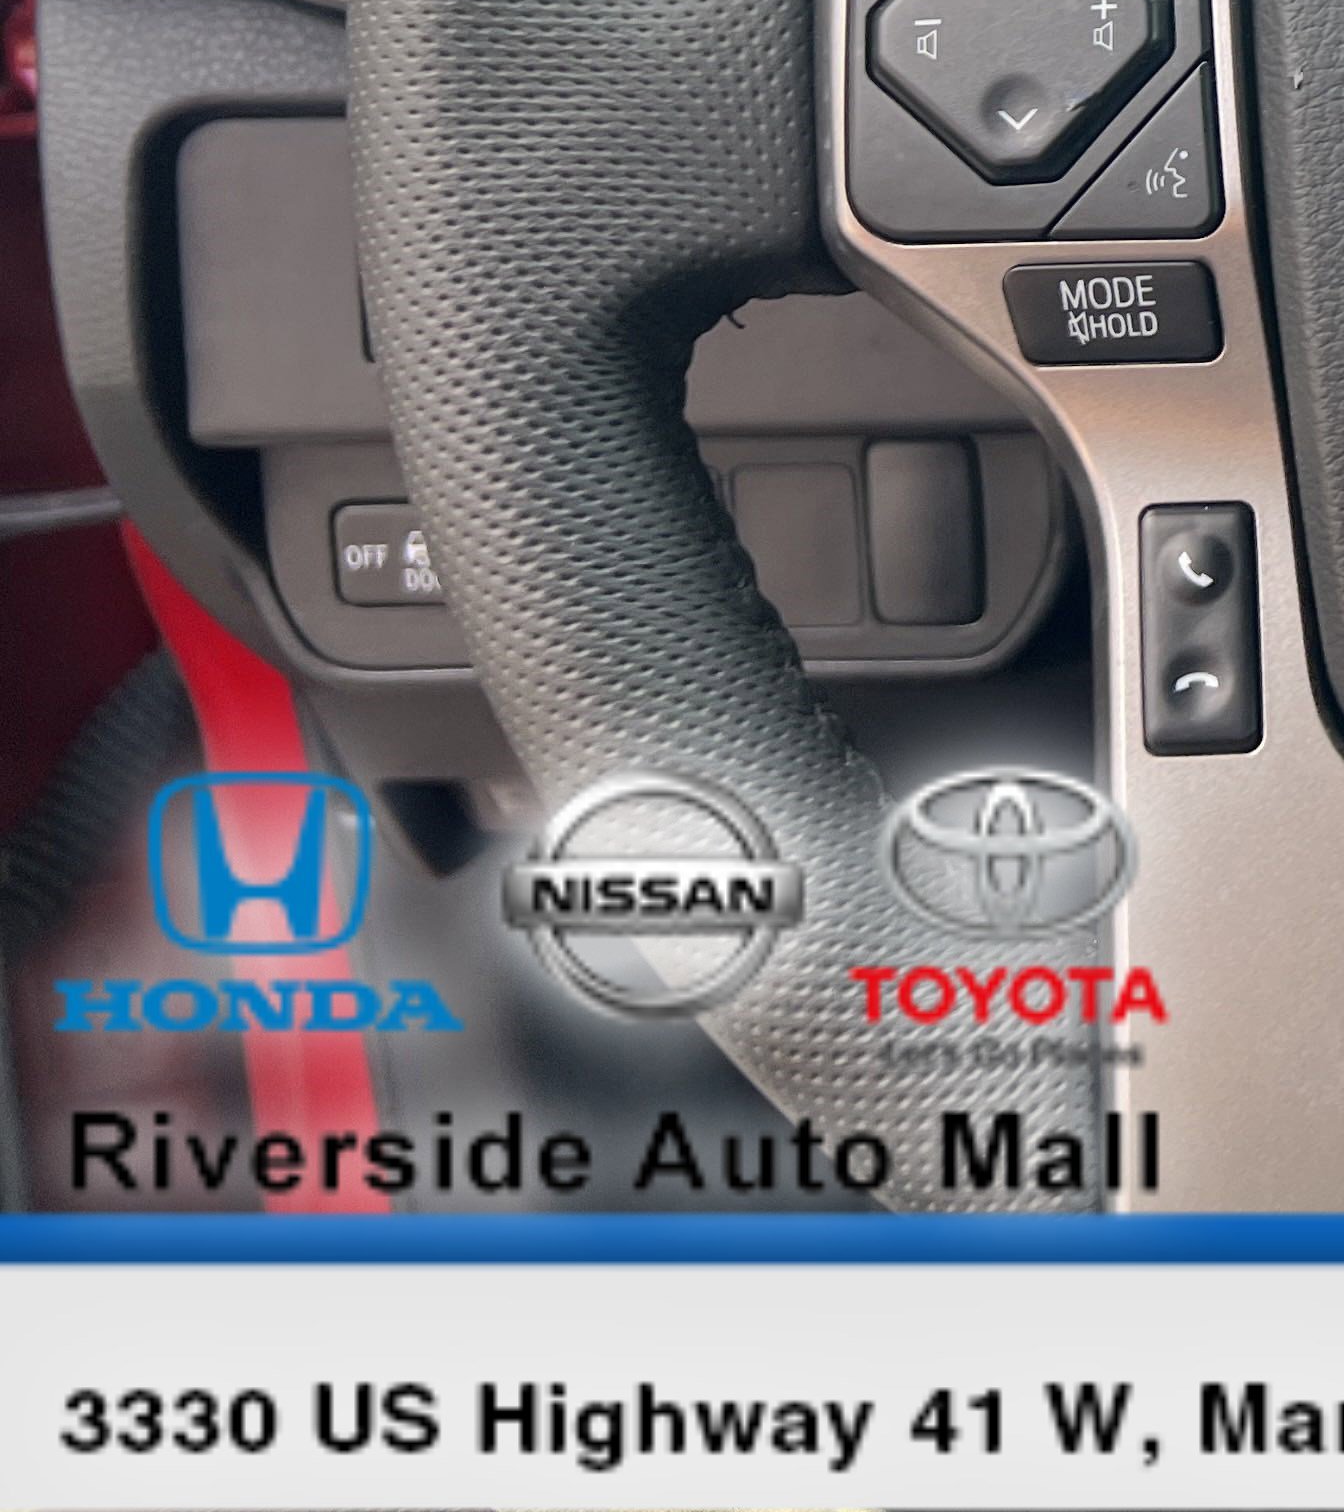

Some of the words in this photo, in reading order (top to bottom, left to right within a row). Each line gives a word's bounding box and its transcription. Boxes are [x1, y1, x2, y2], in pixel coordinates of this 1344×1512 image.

[1059, 274, 1157, 311] MODE
[1089, 310, 1158, 341] HOLD
[345, 543, 389, 570] OFF
